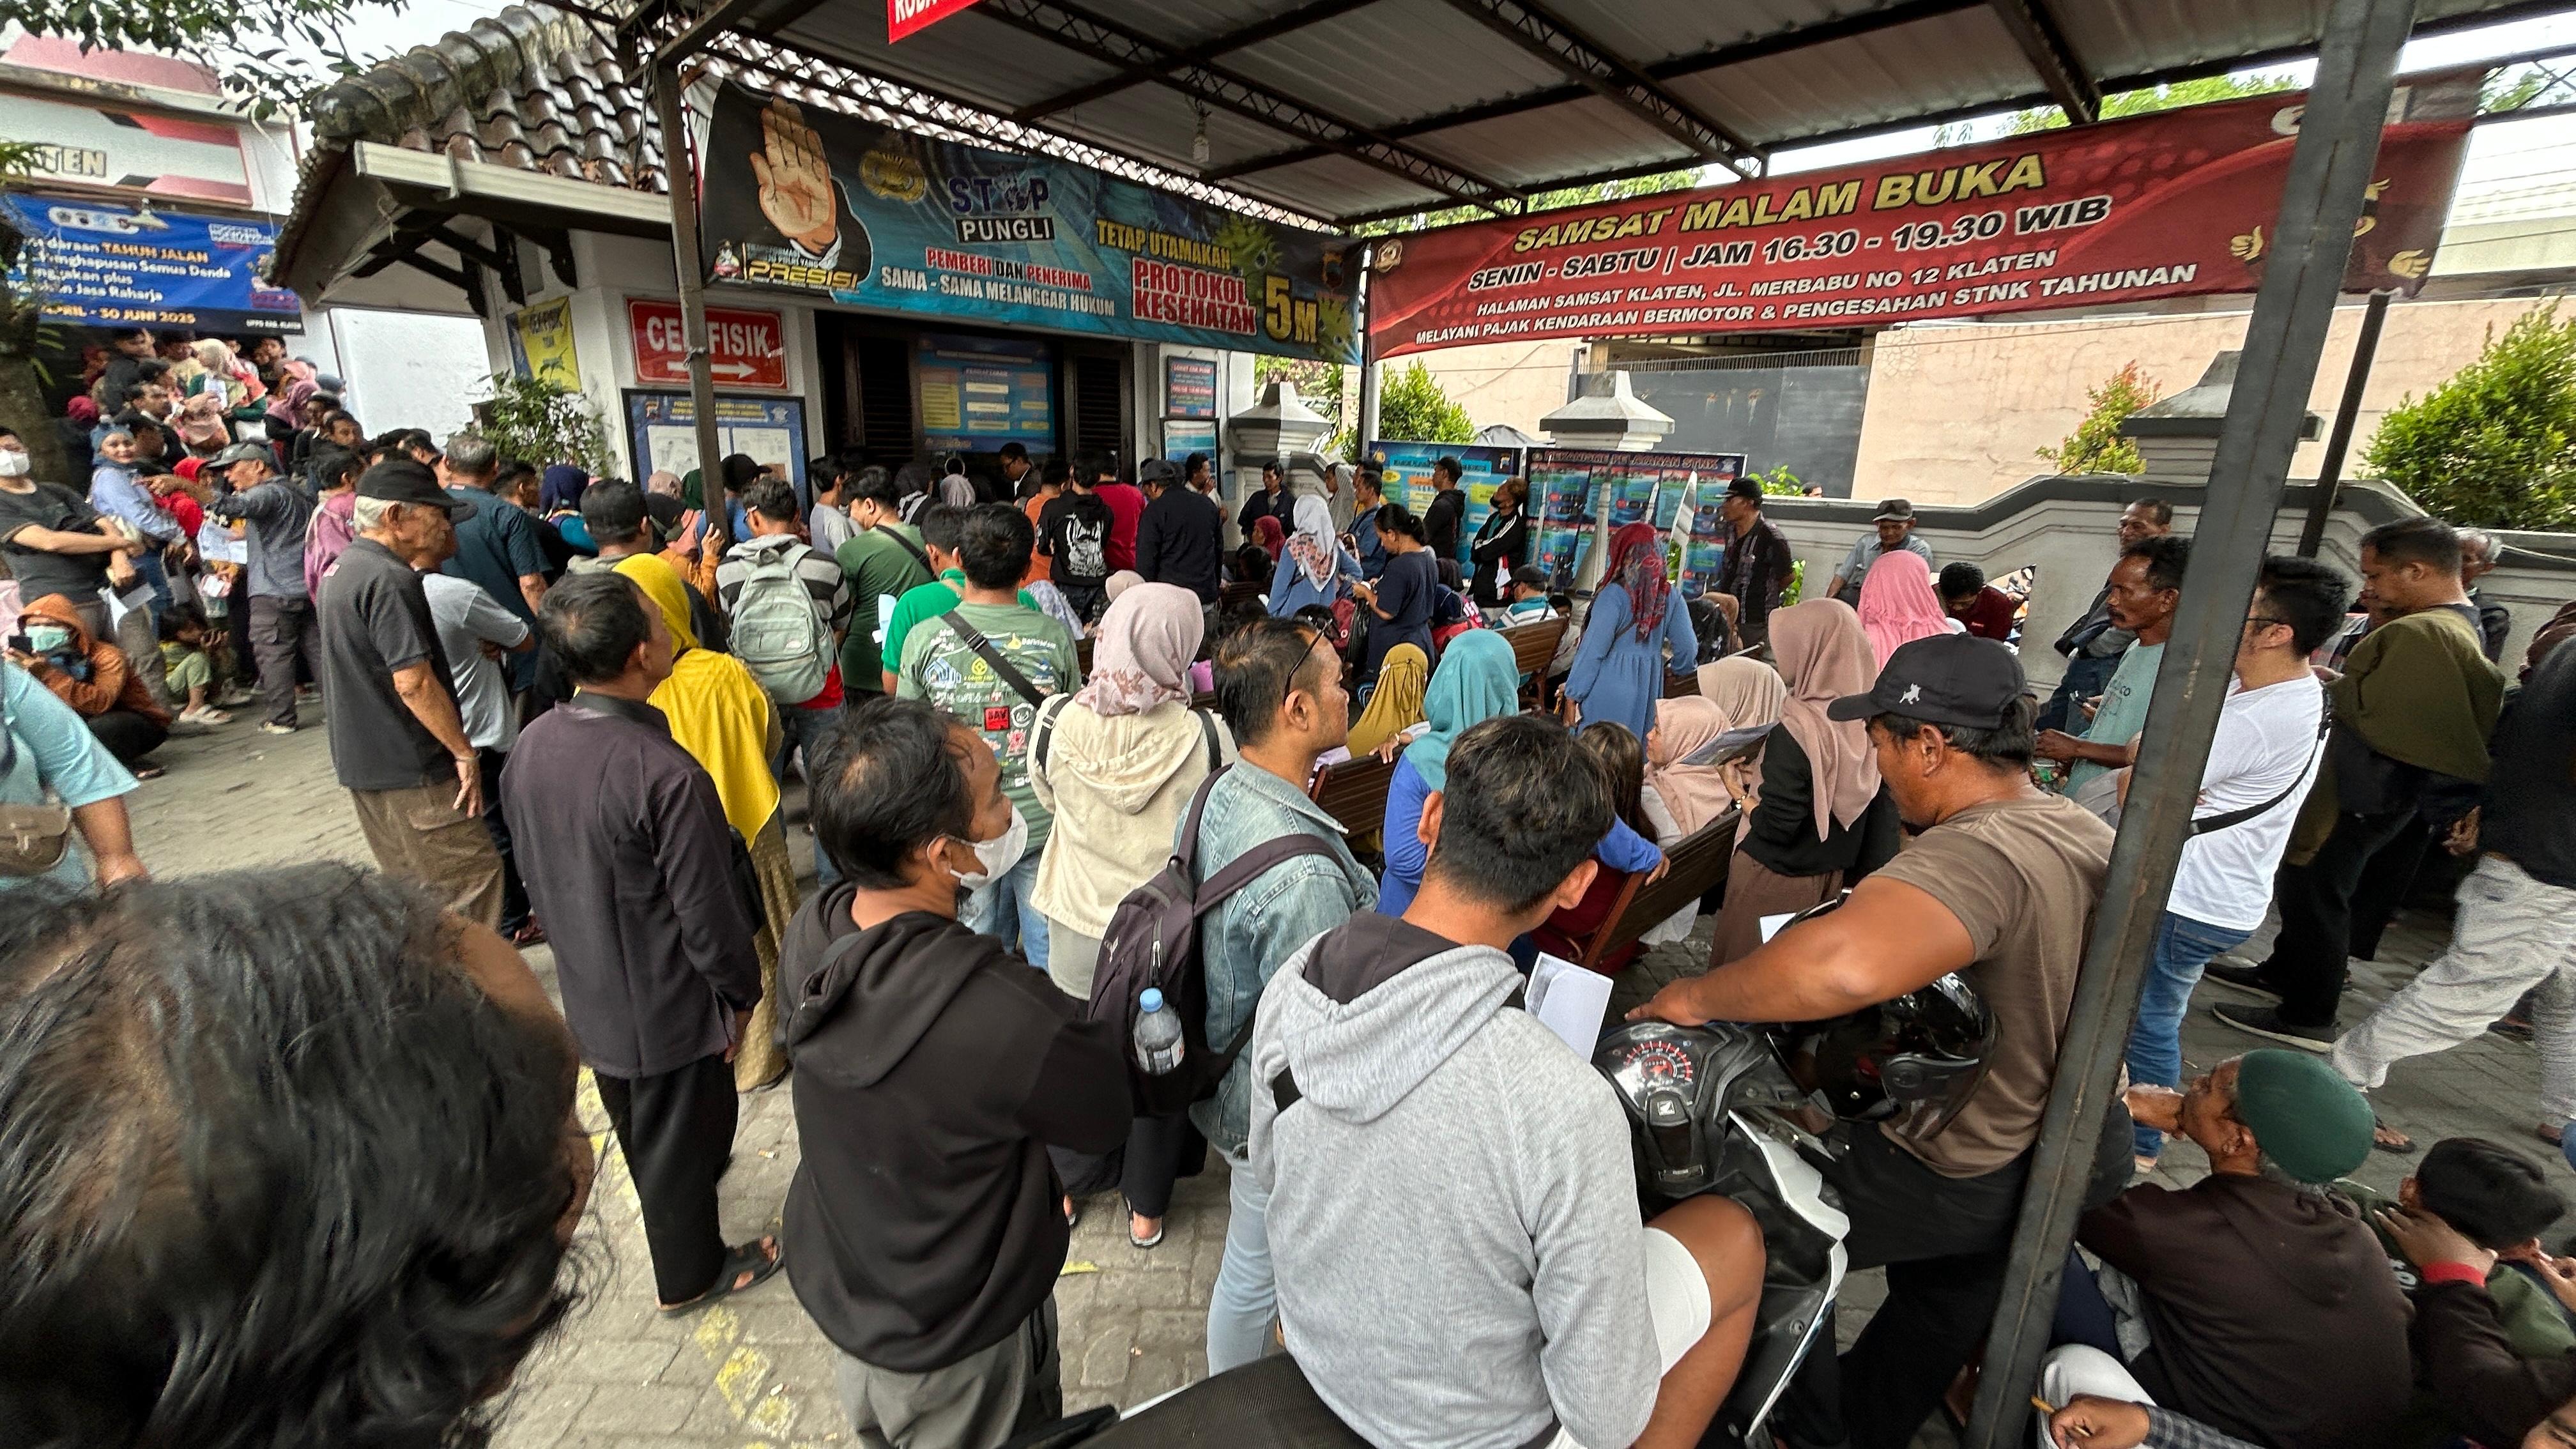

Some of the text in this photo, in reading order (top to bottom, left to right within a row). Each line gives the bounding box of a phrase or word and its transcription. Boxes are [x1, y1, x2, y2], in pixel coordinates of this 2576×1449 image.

[1514, 153, 2044, 252] SAMSAT MALAM BUKA
[962, 218, 1050, 241] PUNGLI
[1096, 219, 1232, 270] TETAP UTAMAKAN
[1469, 261, 1544, 291] SENIN
[1563, 247, 1659, 279] SABTU
[1681, 241, 1754, 268] JAM
[1763, 229, 1859, 264] 16.30
[1892, 211, 2005, 252] 19.30
[2015, 195, 2112, 235] WIB
[139, 259, 187, 275] Semua
[188, 264, 231, 279] Denda
[161, 249, 208, 263] JALAN
[749, 260, 858, 288] PRESISI
[926, 247, 1092, 292] PEMBERI DAN PENERIMA
[109, 285, 163, 303] Raharja
[881, 266, 928, 291] SAMA
[940, 274, 983, 298] SAMA
[986, 280, 1068, 309] MELANGGAR
[1070, 293, 1115, 316] HUKUM
[1133, 258, 1317, 344] PROTOKOL 5M
[1416, 263, 2198, 345] MELAYANI PAJAK KENDARAAN BERMOTOR & PENGESAHAN STNK TAHUNAN
[1476, 250, 2057, 317] HALAMAN SAMSAT KLATEN, JL. MERBABU NO 12 KLATEN
[1133, 289, 1257, 335] KESEHATAN
[706, 321, 770, 358] FISIK
